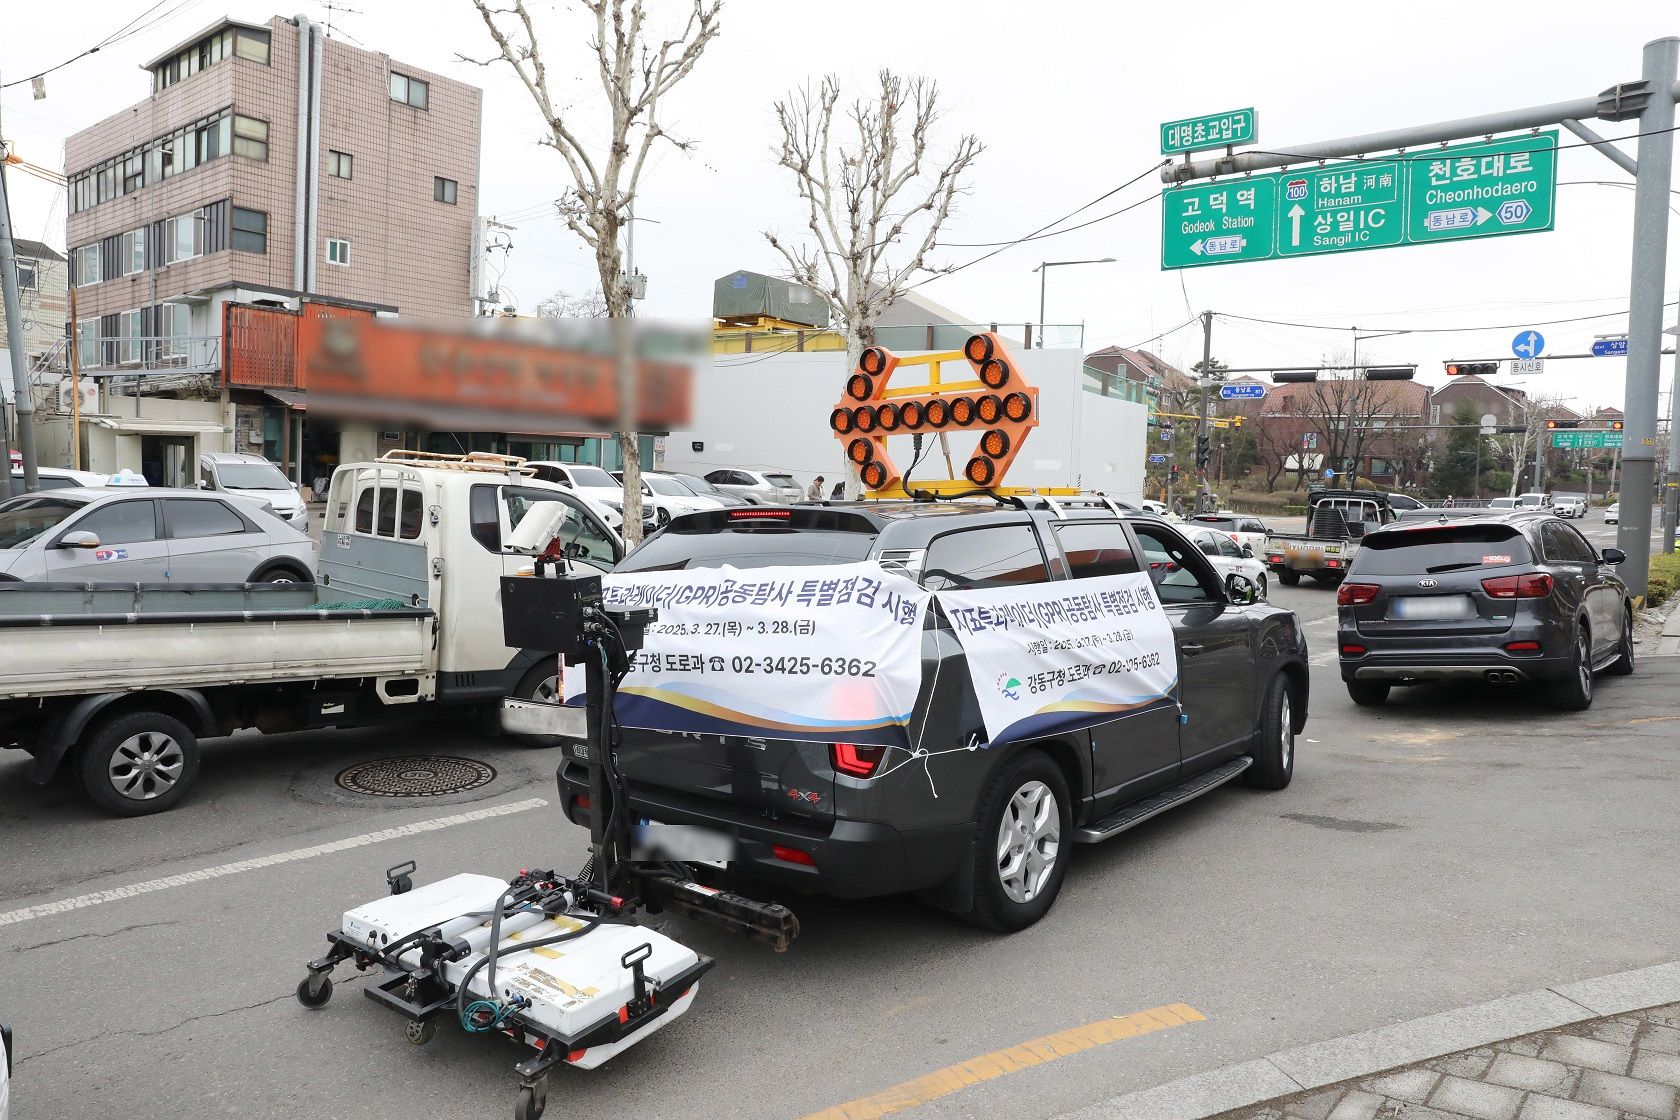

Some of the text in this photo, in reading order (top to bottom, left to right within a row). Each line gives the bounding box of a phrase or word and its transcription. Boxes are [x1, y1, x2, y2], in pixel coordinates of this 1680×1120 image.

[1168, 115, 1246, 147] 대명초교입구
[1428, 152, 1533, 186] 천호대로
[1290, 186, 1305, 198] 100
[1319, 173, 1392, 194] 하남 河南
[1426, 180, 1537, 205] Cheonhodaero
[1318, 195, 1362, 208] Hanam
[1504, 204, 1524, 220] 50
[1181, 214, 1254, 234] Godeok Station
[1313, 230, 1370, 246] Sangil IC
[1610, 341, 1627, 350] 상암
[1512, 362, 1542, 373] 동시신호
[1421, 579, 1435, 587] KIA
[796, 575, 882, 609] 특별점검
[881, 590, 918, 626] 시행
[1100, 588, 1139, 616] 특별점검
[1134, 585, 1156, 611] 시행
[772, 619, 816, 636] 28.(금)
[625, 653, 877, 678] 동구청 도로과 02-3425-6362
[1027, 668, 1067, 695] 강동구청
[1067, 663, 1092, 683] 도로과
